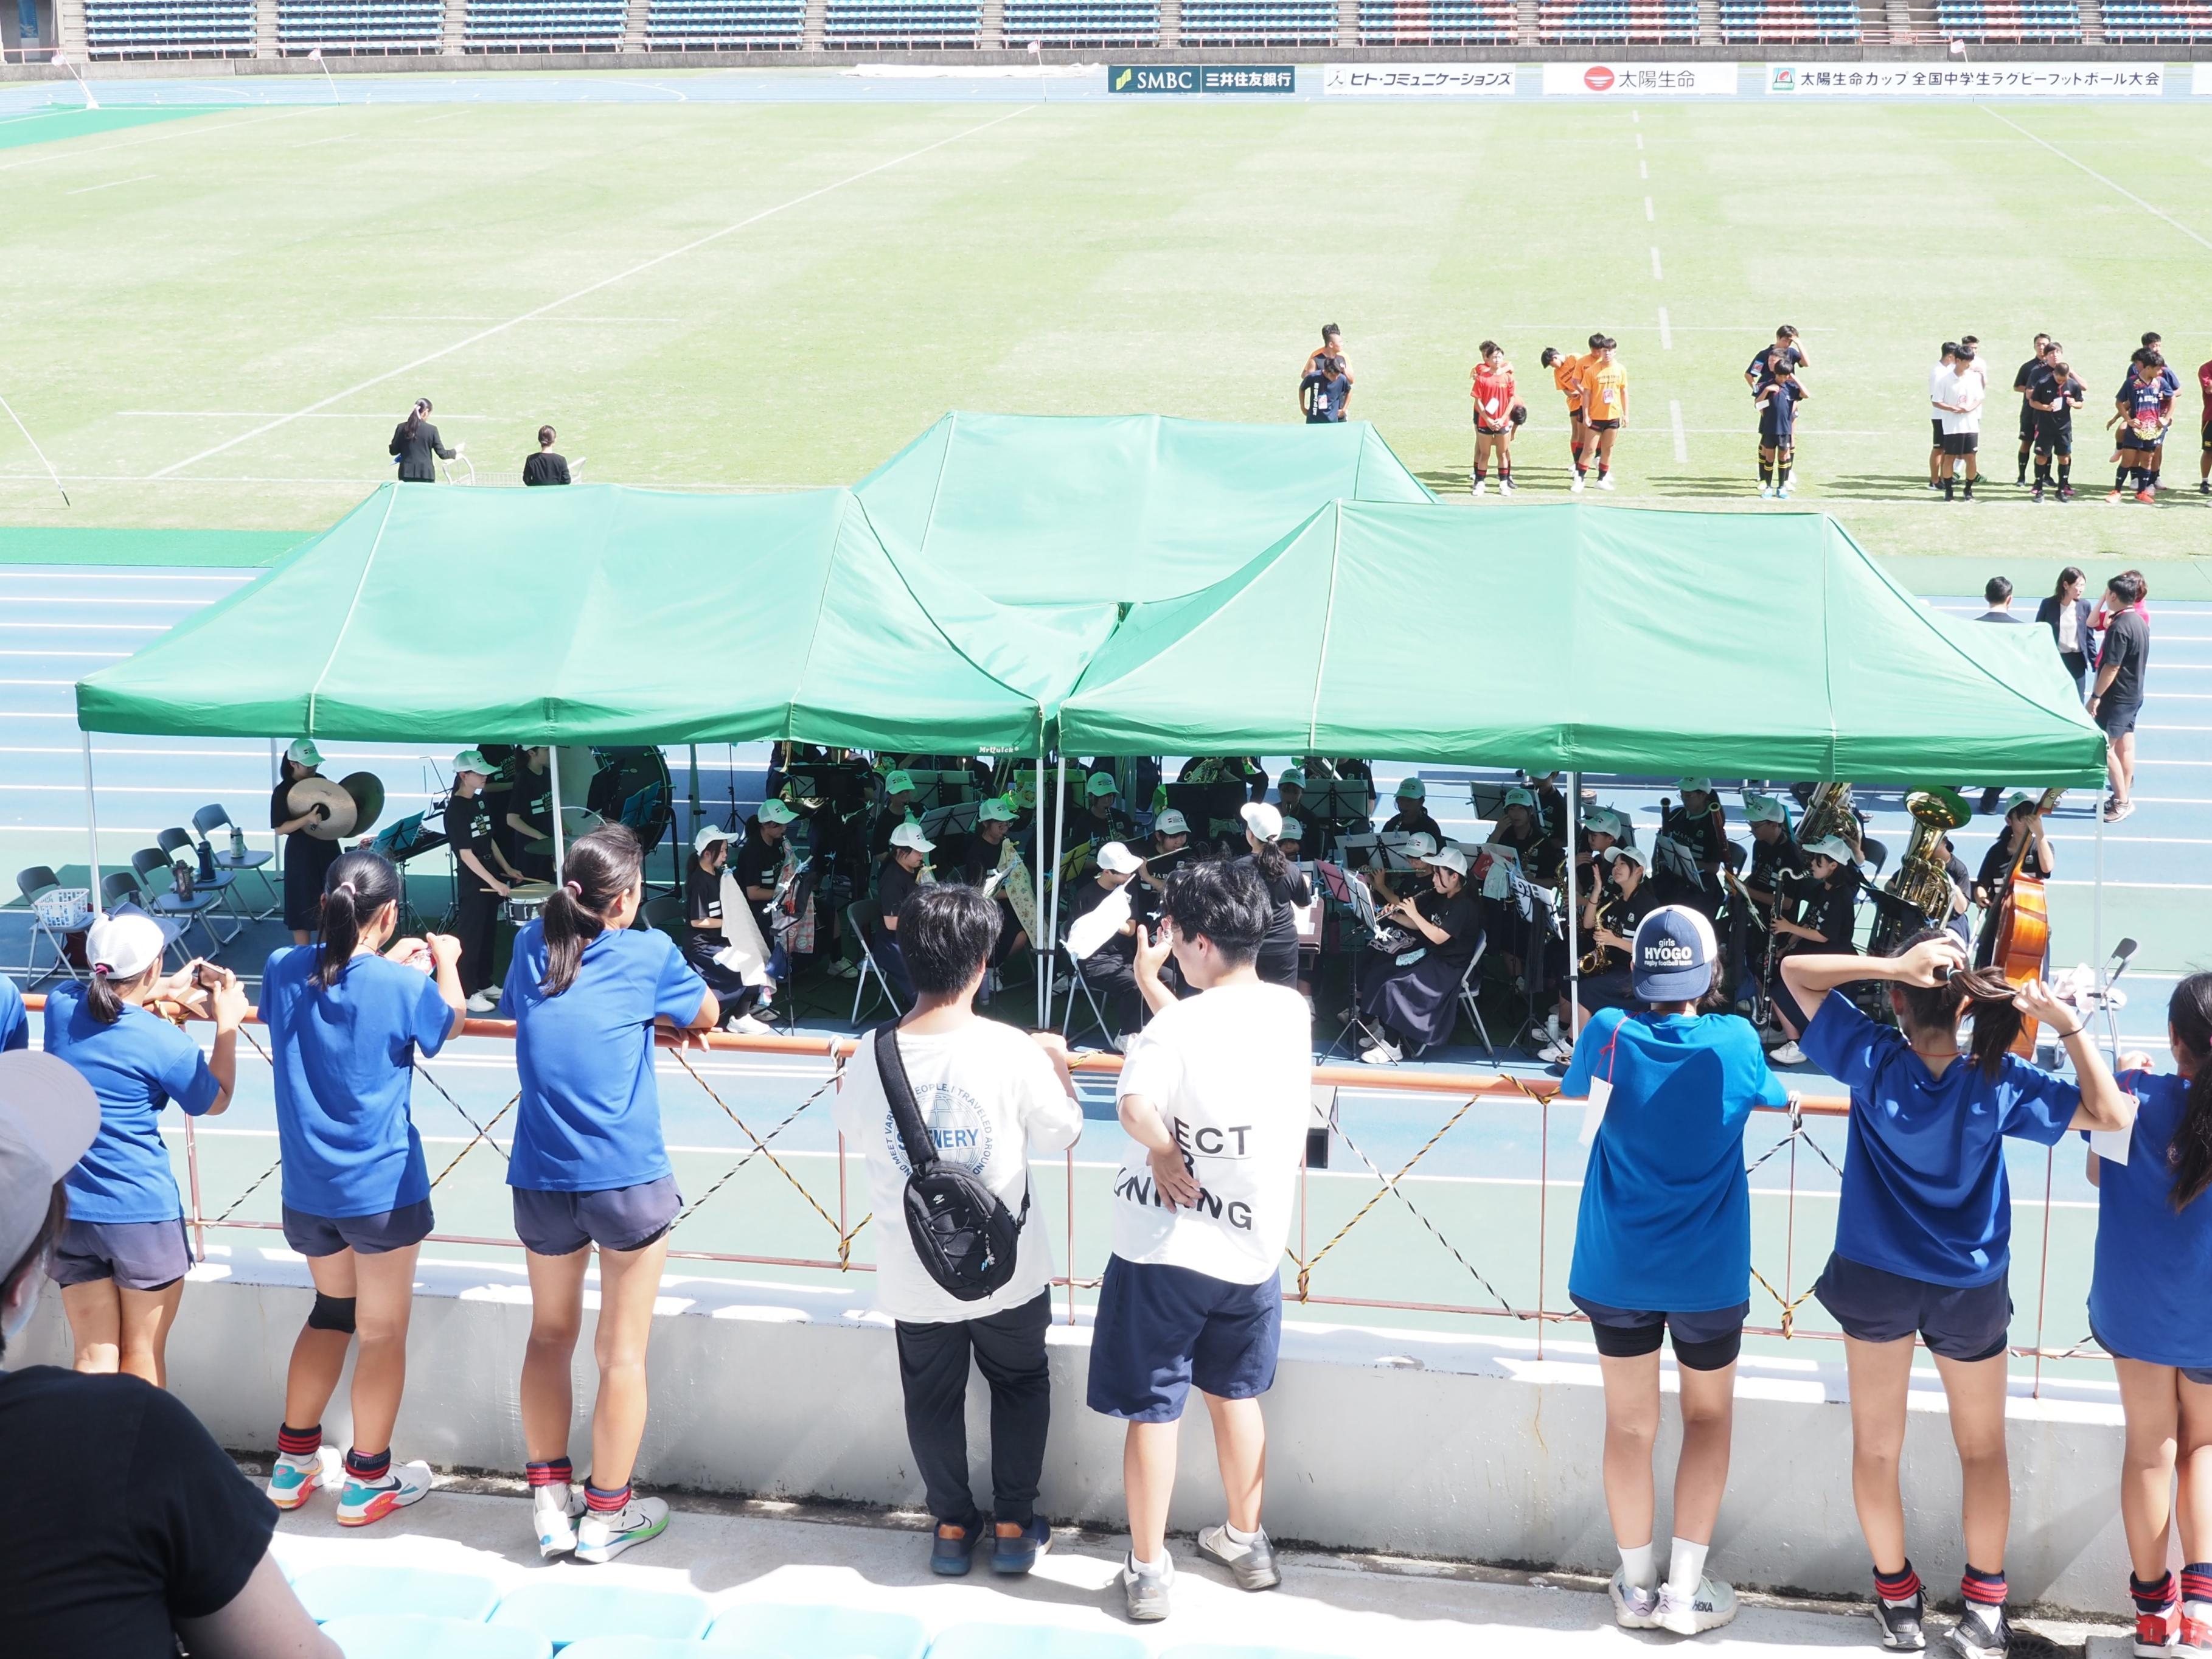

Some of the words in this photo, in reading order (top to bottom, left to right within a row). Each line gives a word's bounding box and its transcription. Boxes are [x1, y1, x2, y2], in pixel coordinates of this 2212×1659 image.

[1137, 72, 1192, 89] SMBC
[1206, 72, 1292, 87] 三井住友銀行
[1351, 71, 1513, 86] ヒト・コミュニケーションズ
[1619, 70, 1696, 88] 太陽生命
[1801, 71, 1909, 86] 太陽生命カップ
[1912, 71, 2160, 86] 全国中学生ラグビーフットボール大会
[1658, 938, 1675, 948] girls
[1644, 947, 1692, 960] HYOGO
[914, 1083, 949, 1095] EOPLE.
[972, 1136, 993, 1175] AROUND
[1173, 1116, 1252, 1155] ECT
[897, 1129, 979, 1150] SNERY
[885, 1138, 900, 1164] MEET
[1692, 1600, 1714, 1613] HOKA
[1960, 1624, 1977, 1638] NIKE
